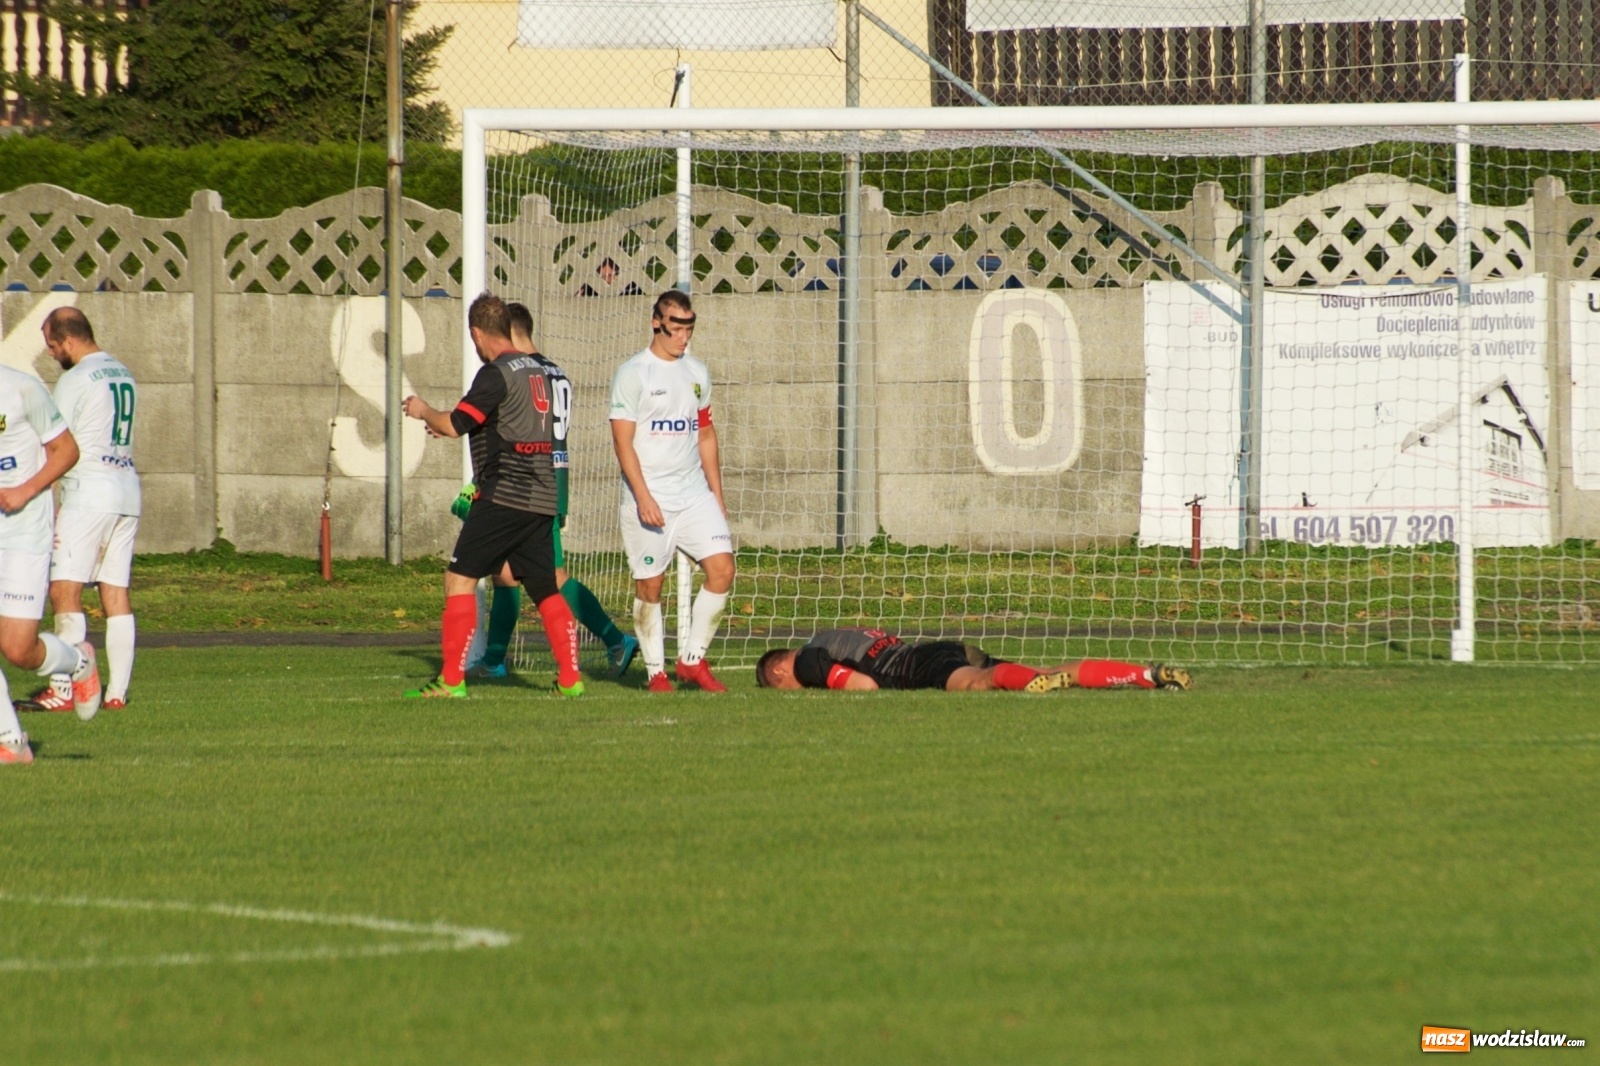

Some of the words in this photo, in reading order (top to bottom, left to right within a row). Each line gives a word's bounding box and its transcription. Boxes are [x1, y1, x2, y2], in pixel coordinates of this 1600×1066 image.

[1321, 293, 1365, 309] Usługi
[1377, 315, 1459, 334] Docieplenia
[1279, 342, 1381, 361] Kompleksowe
[1485, 340, 1536, 359] wnętrz
[109, 382, 135, 446] 19
[1294, 516, 1341, 543] 604
[1350, 516, 1397, 543] 507
[1407, 515, 1454, 542] 320
